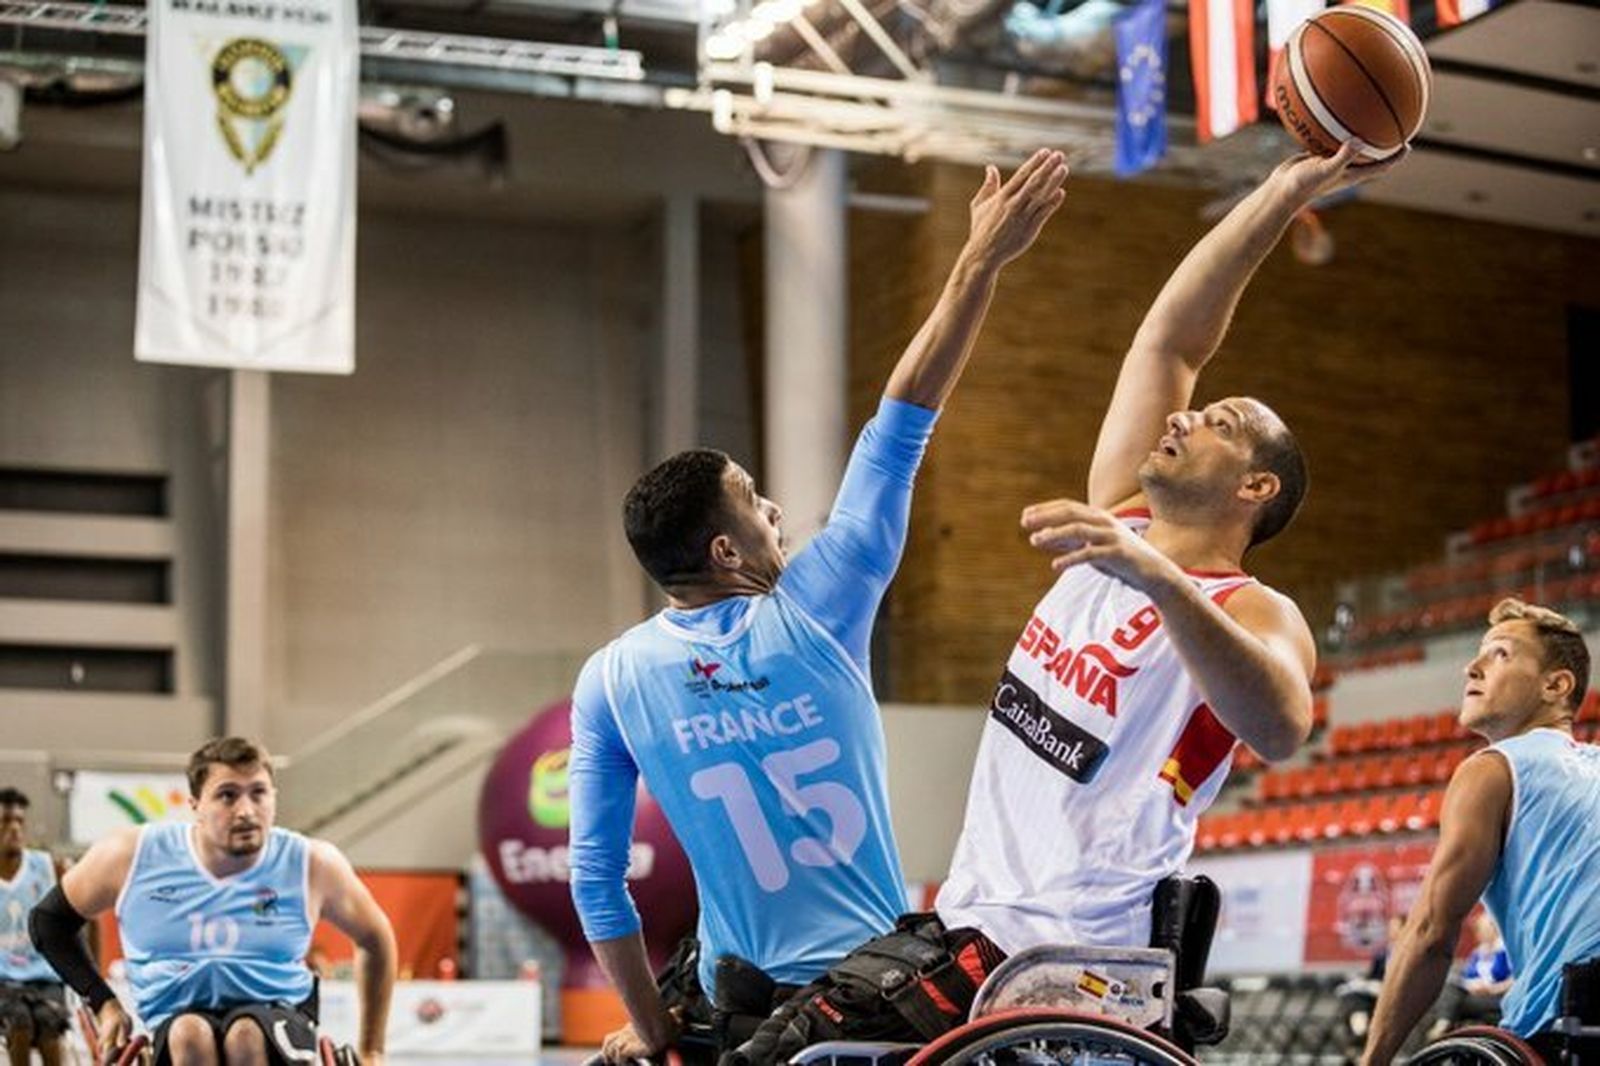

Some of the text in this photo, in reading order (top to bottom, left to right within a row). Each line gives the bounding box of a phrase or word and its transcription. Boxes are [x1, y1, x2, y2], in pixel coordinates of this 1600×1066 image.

[1111, 605, 1163, 651] 9
[1018, 615, 1139, 718] SPAÑA
[672, 693, 824, 754] FRANCE
[995, 683, 1085, 771] CaixaBank
[690, 738, 867, 892] 15
[187, 912, 240, 955] 10
